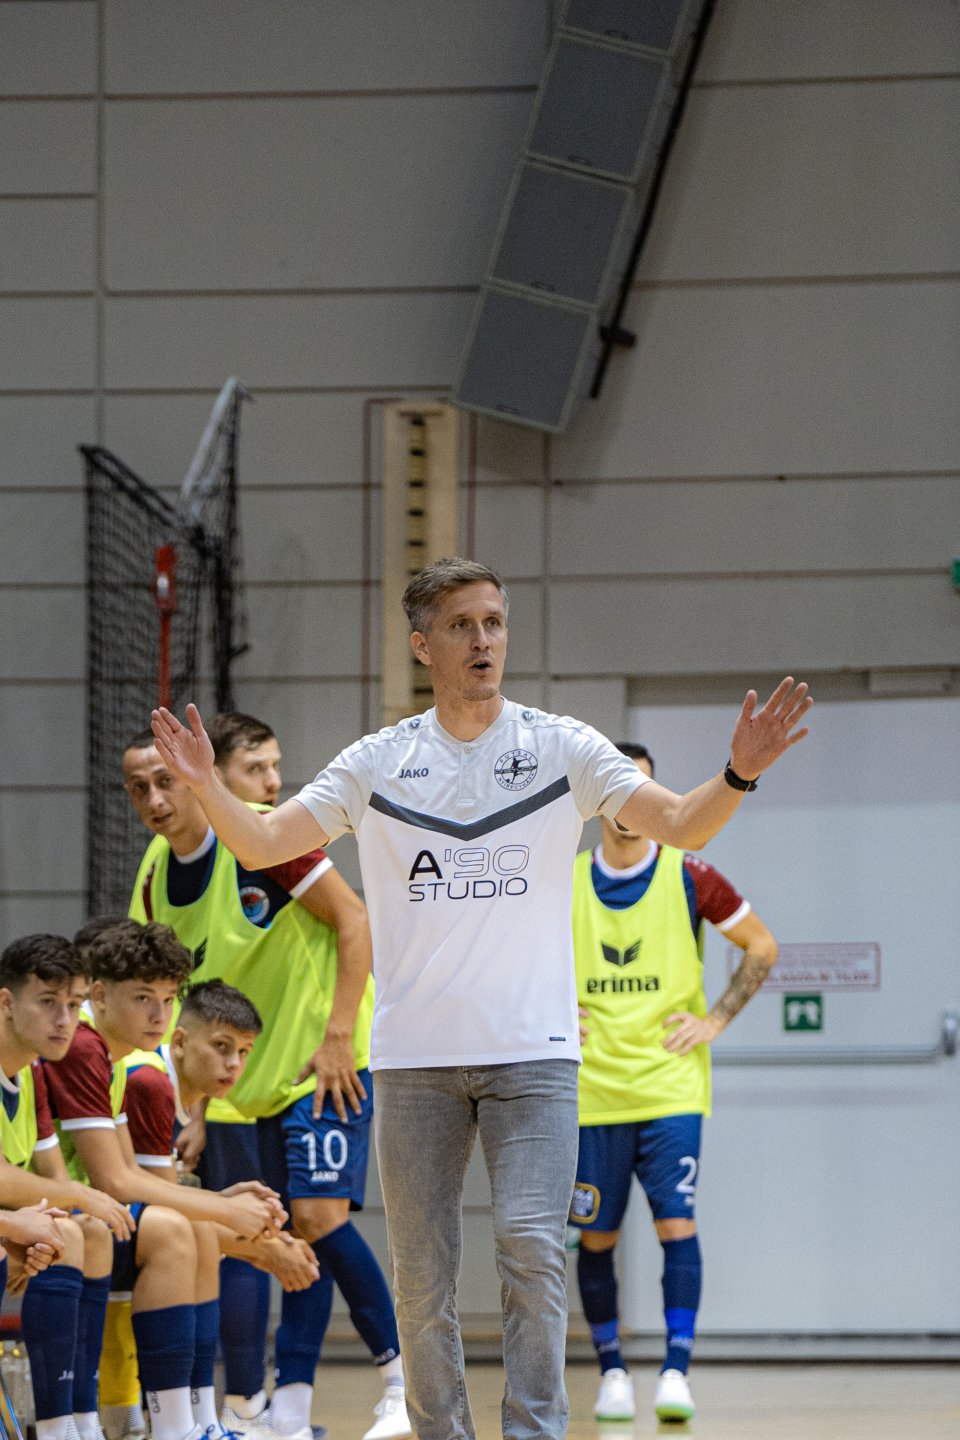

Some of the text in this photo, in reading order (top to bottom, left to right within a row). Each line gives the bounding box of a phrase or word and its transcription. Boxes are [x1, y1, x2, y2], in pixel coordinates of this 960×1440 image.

[399, 767, 430, 779] JAKO
[408, 844, 530, 881] A'90
[408, 877, 528, 902] STUDIO
[587, 973, 660, 994] erima
[301, 1129, 349, 1171] 10
[675, 1155, 697, 1194] 2
